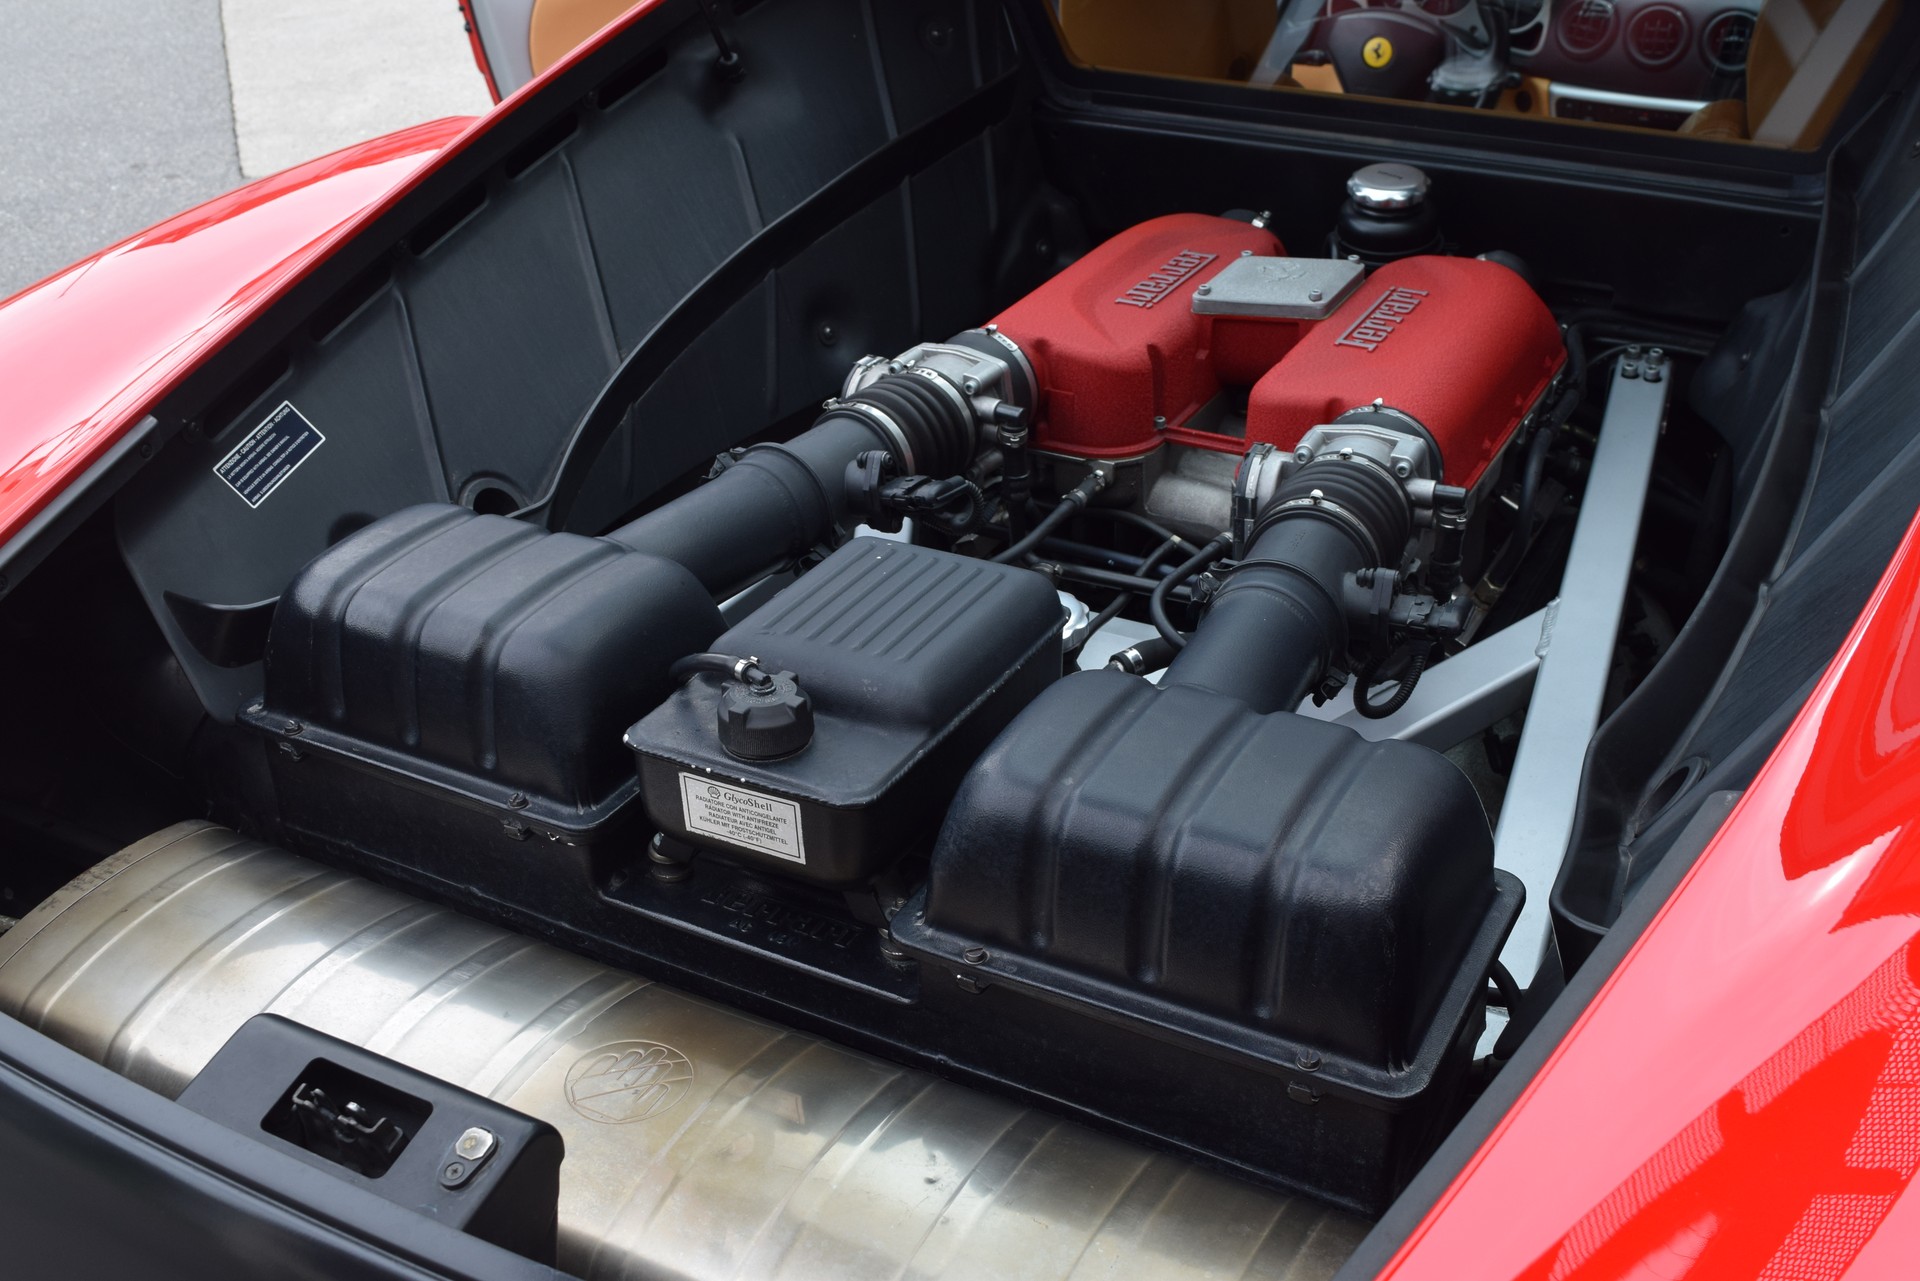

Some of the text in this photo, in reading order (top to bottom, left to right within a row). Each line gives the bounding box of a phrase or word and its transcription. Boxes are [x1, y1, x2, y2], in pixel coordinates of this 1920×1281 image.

[1115, 249, 1220, 309] Ferrari
[1334, 286, 1429, 352] Ferrari
[240, 439, 256, 454] CAUTION
[695, 794, 787, 825] RADIATORE CON ANTICONGELANTE
[723, 791, 773, 812] GlycoShell
[704, 803, 779, 829] RADIATOR WITH ANTIFREEZE
[708, 811, 776, 835] RADIATEUR AVEC ANTIGEL
